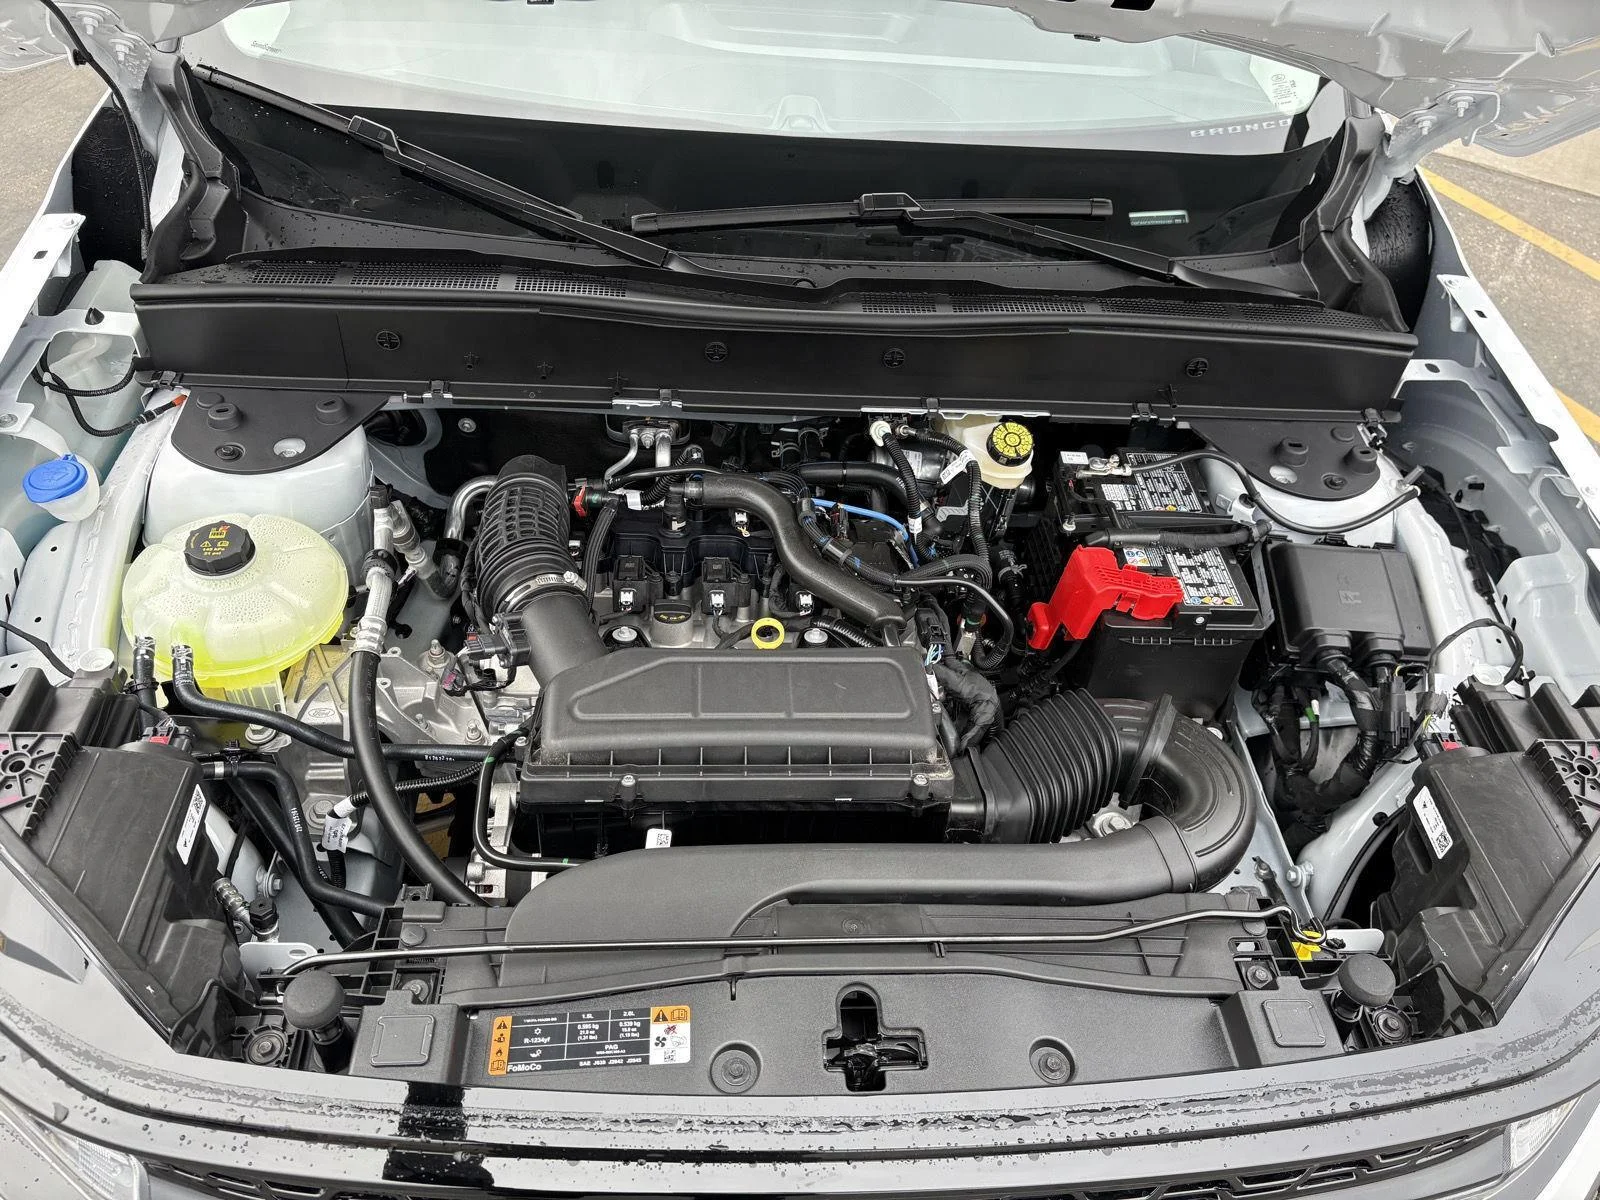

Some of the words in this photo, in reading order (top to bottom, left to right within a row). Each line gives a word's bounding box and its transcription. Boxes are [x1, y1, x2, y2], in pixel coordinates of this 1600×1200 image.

[1190, 118, 1292, 137] BRONCO
[633, 1020, 641, 1028] kg
[523, 1036, 551, 1044] R-1234yf
[507, 1063, 542, 1072] FoMoCo
